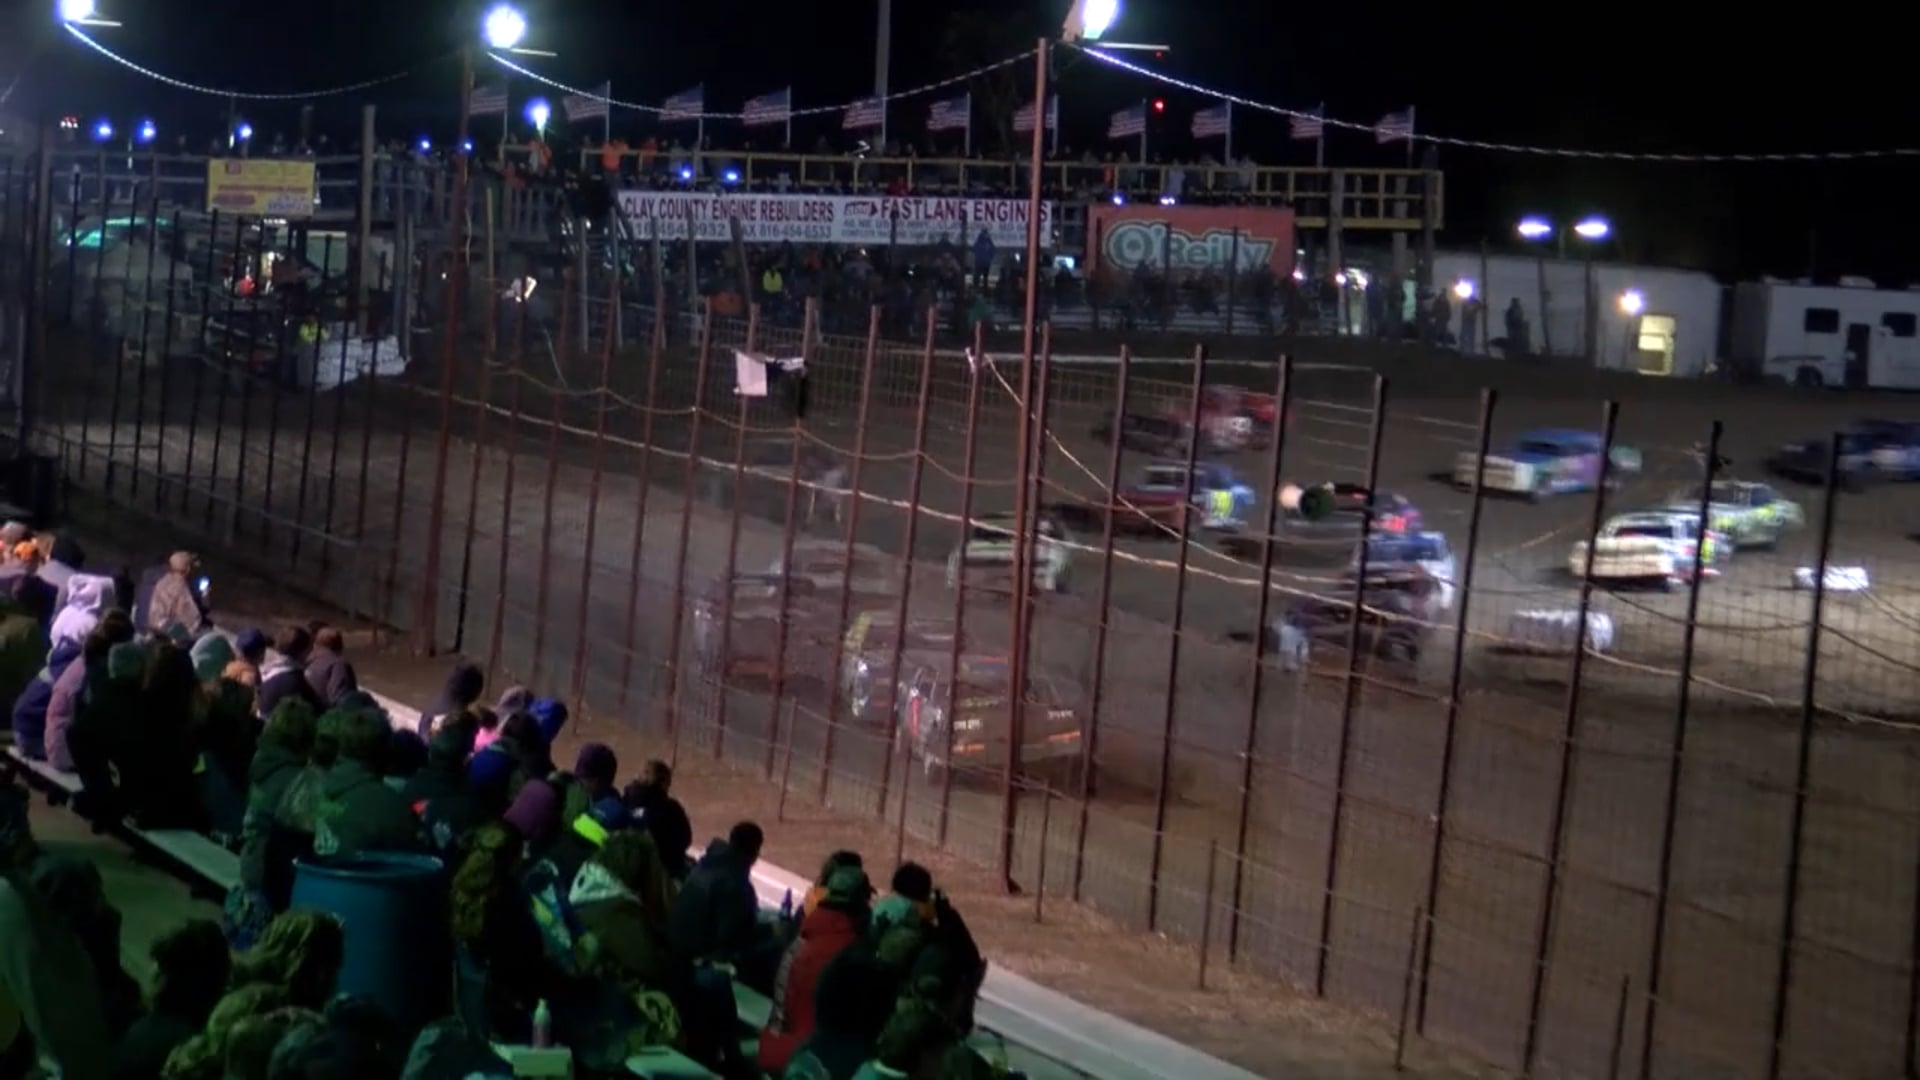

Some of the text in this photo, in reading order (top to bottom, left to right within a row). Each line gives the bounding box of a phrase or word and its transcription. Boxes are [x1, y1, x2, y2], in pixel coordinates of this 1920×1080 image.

[625, 198, 655, 219] CLAY
[659, 198, 708, 220] COUNTY
[712, 199, 757, 221] ENGINE
[760, 200, 834, 223] REBUILDERS
[881, 199, 968, 221] FASTLANE
[974, 201, 1049, 222] ENGINS
[1107, 223, 1272, 271] O'Reily
